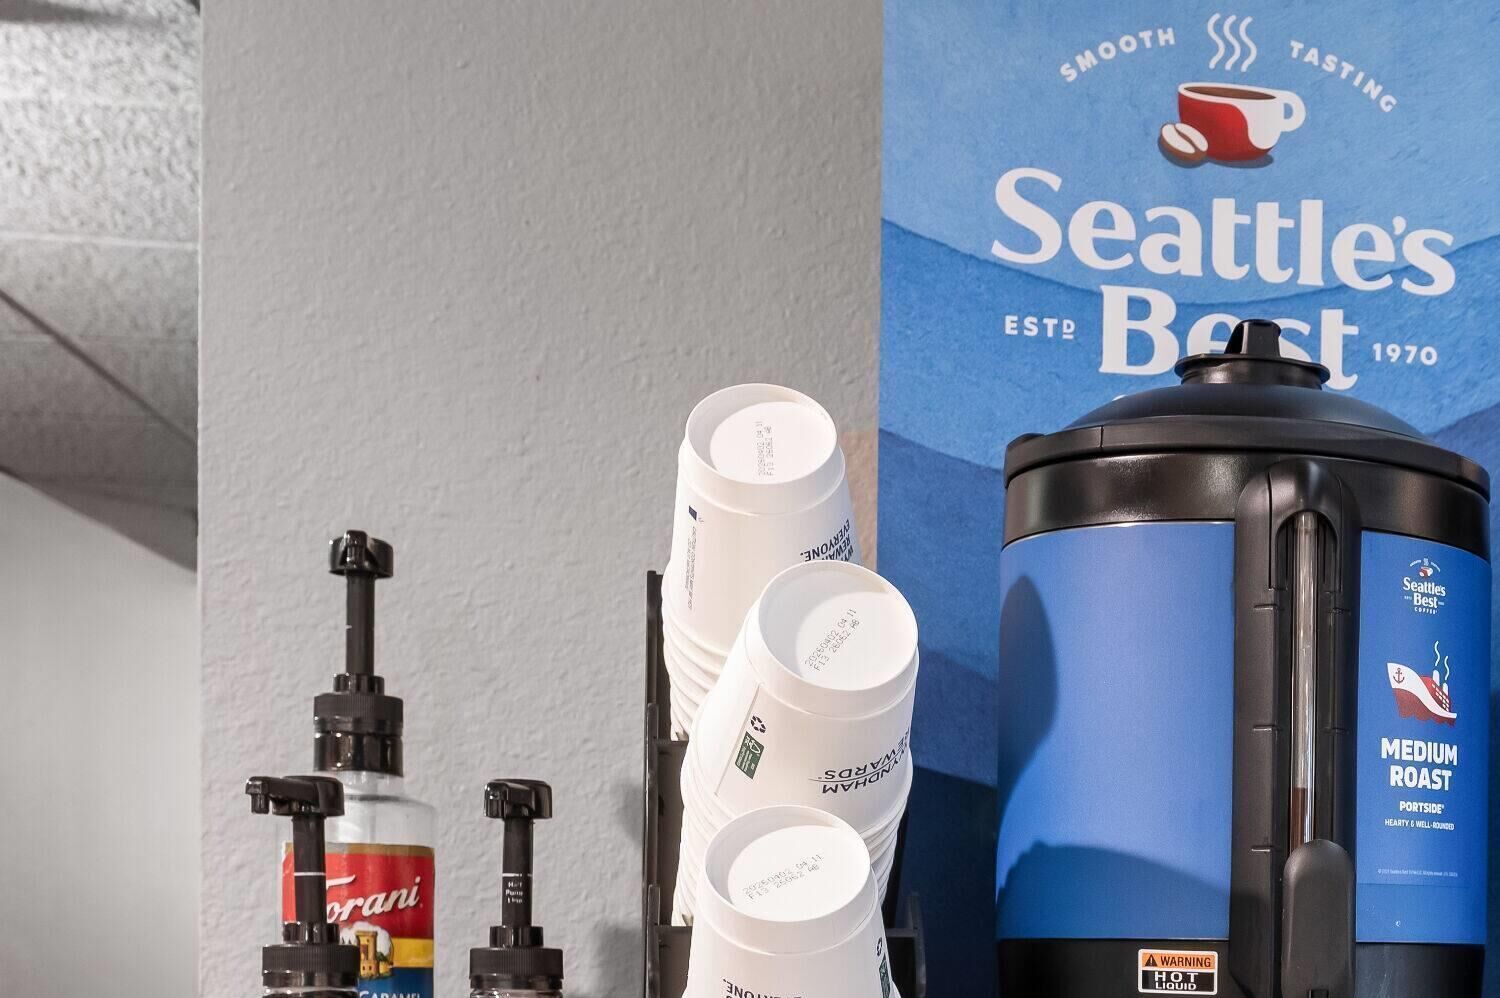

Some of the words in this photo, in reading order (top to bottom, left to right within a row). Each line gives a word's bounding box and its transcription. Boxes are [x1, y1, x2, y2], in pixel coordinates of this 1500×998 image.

[1059, 27, 1176, 83] SMOOTH
[1290, 40, 1398, 113] TASTING
[991, 167, 1456, 296] Seattle's
[1371, 342, 1438, 365] 1970
[822, 534, 851, 561] REWA
[1403, 577, 1446, 597] Seattle's
[1413, 592, 1437, 608] Best
[1381, 737, 1458, 766] MEDIUM
[1389, 765, 1452, 791] ROAST
[1384, 818, 1409, 828] HEARTY
[1415, 821, 1455, 831] WELL-ROUNDED
[1160, 956, 1211, 968] WARNING
[1154, 971, 1198, 983] HOT
[1155, 981, 1197, 991] LIQUID
